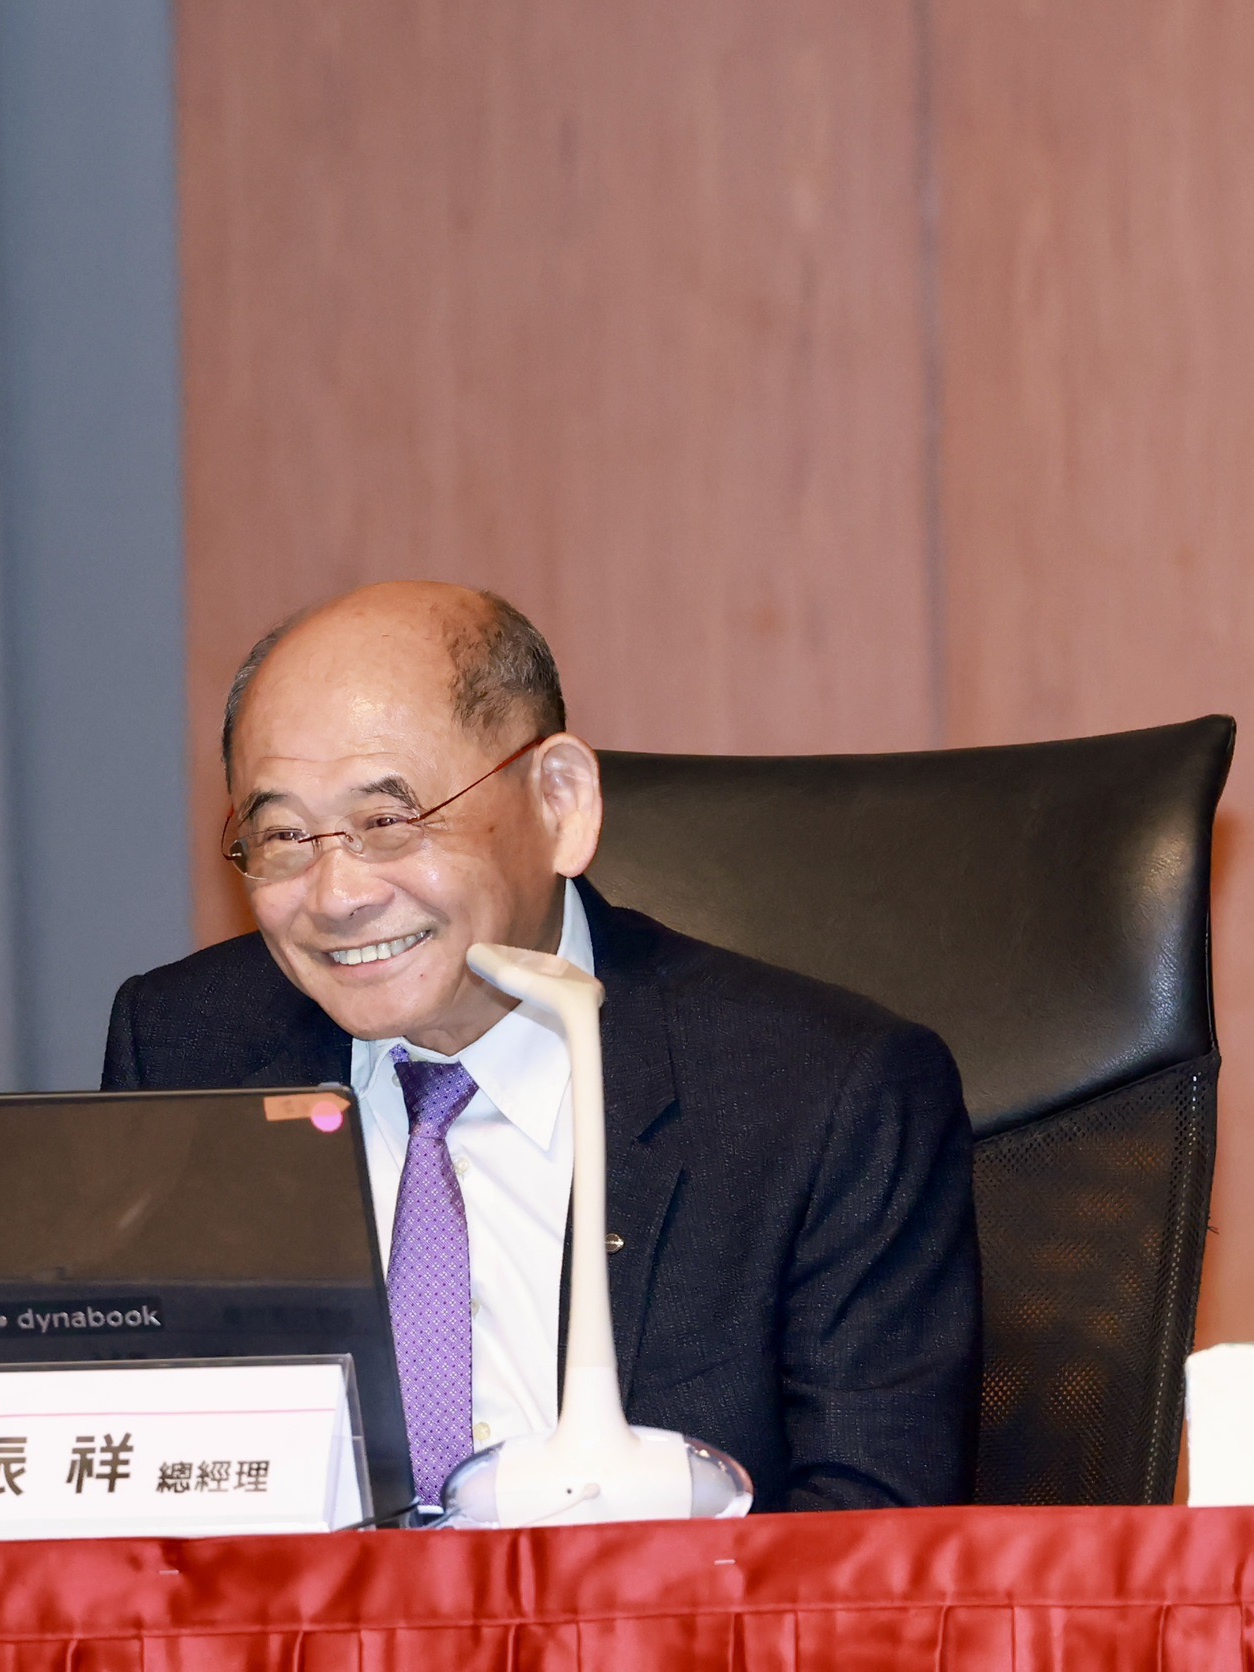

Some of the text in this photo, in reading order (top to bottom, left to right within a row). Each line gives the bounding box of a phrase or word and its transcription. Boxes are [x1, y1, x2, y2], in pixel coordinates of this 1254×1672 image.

[17, 1305, 161, 1333] dynabook
[156, 1460, 270, 1493] 總經理
